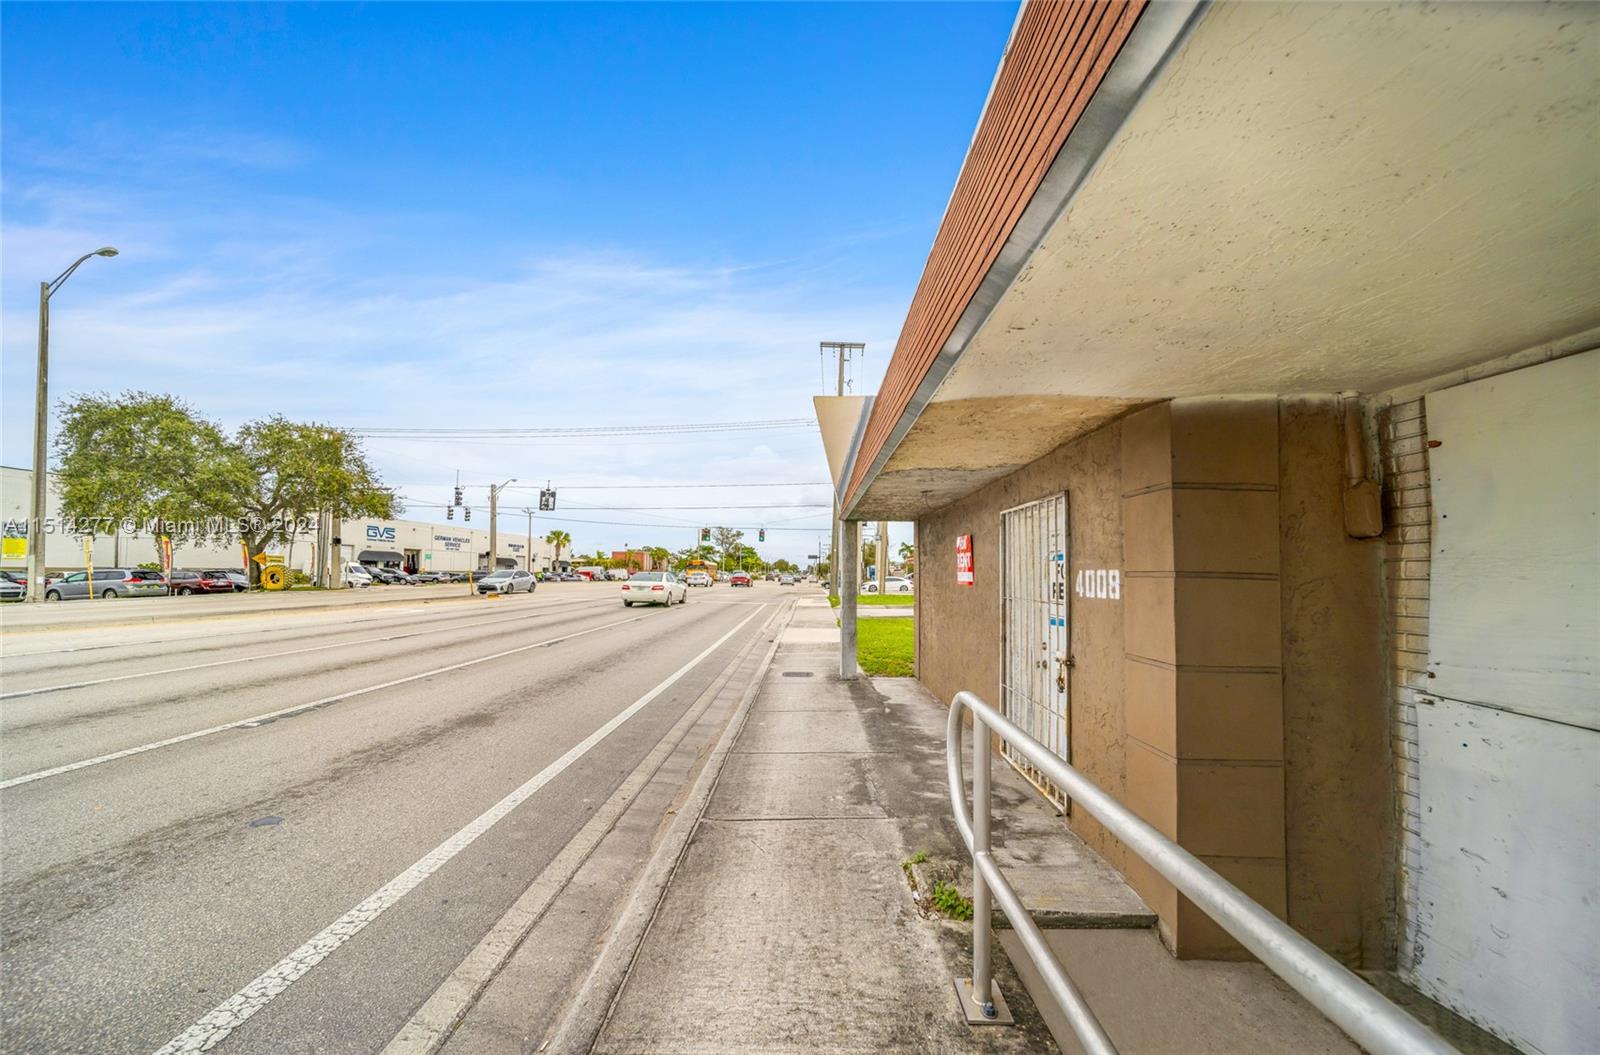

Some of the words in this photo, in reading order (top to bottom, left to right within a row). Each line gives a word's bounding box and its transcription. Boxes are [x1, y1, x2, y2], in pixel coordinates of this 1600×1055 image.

[366, 525, 396, 540] GVS
[452, 536, 470, 544] VEHICLES
[1075, 569, 1120, 600] 4008
